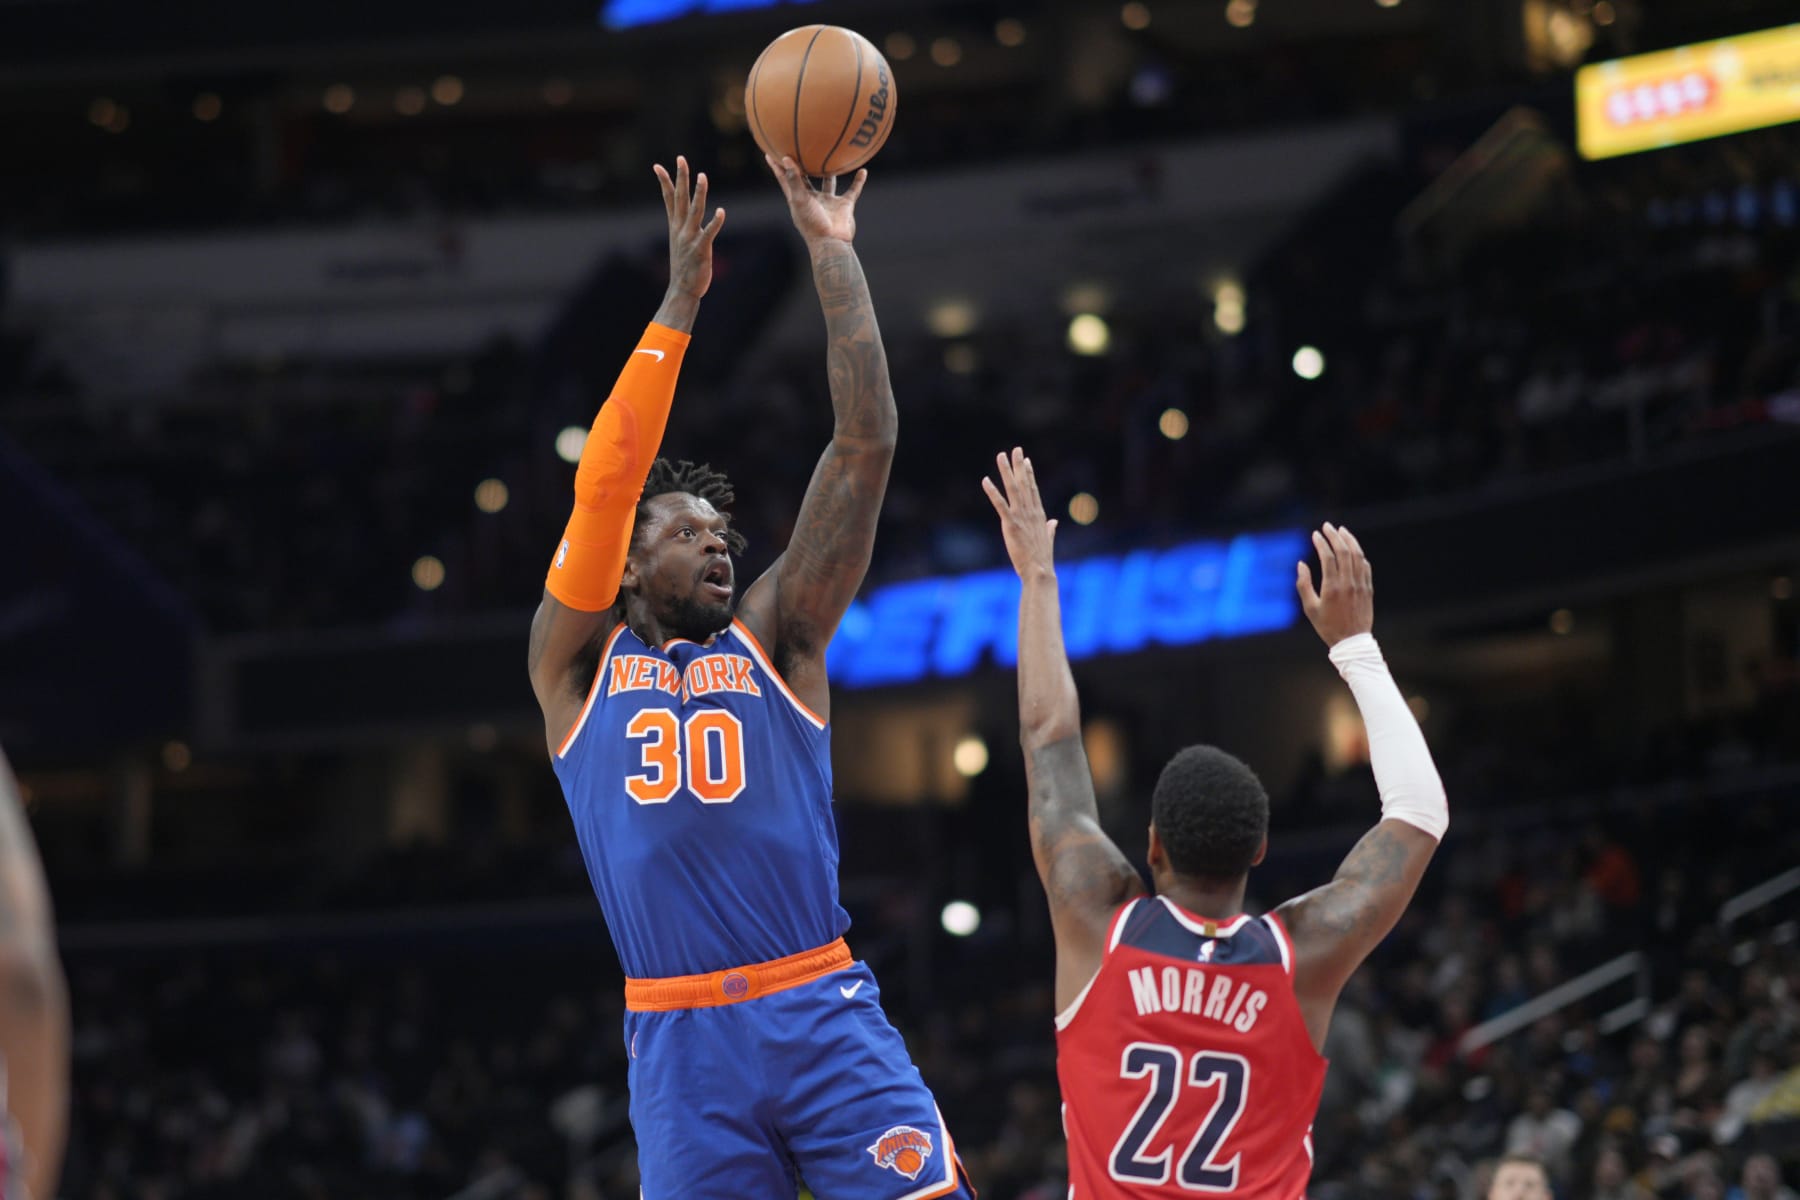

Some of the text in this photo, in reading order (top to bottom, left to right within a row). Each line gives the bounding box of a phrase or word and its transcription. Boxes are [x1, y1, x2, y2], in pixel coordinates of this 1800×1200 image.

[607, 654, 682, 698] NEW
[625, 708, 746, 805] 30
[1128, 966, 1268, 1033] MORRIS
[1108, 1041, 1250, 1193] 22
